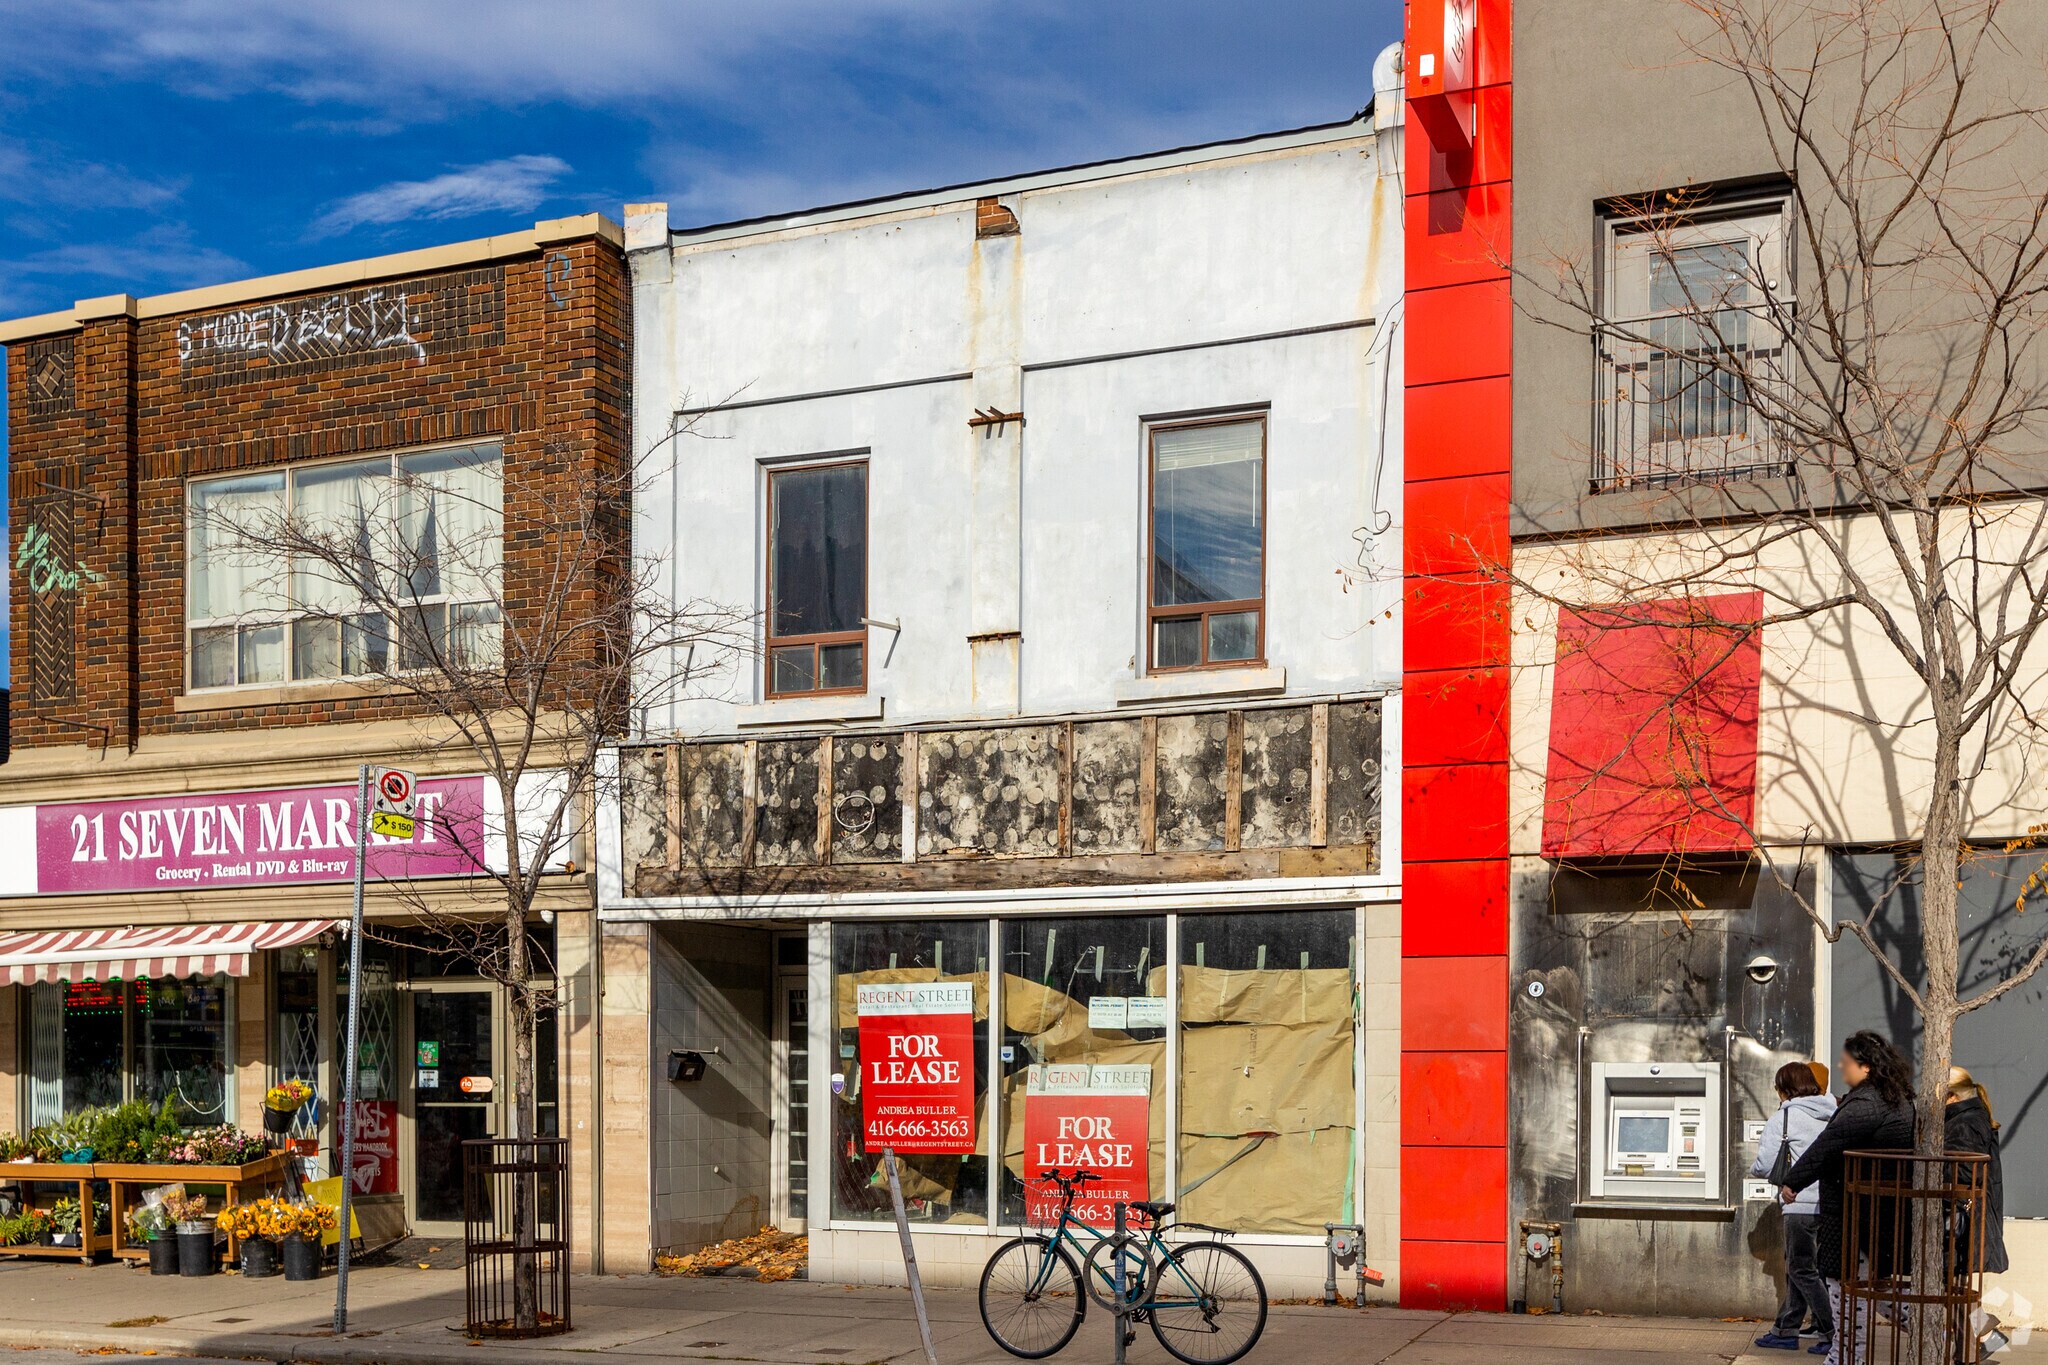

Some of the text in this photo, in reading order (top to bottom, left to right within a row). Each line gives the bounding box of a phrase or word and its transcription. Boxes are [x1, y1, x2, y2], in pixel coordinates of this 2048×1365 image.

[70, 812, 108, 862] 21
[118, 804, 247, 861] SEVEN
[398, 822, 412, 832] 150
[155, 858, 349, 881] Grocery Rental DVD & Blu-ray
[859, 988, 972, 1004] REGENT STREET
[887, 1034, 944, 1059] FOR
[871, 1060, 961, 1085] LEASE
[1029, 1070, 1150, 1084] RGENT STREET
[460, 1079, 473, 1088] ria
[877, 1105, 957, 1115] ANDREA BULLER
[868, 1119, 969, 1137] 416-666-3563
[1056, 1115, 1116, 1140] FOR
[1037, 1143, 1134, 1168] LEASE
[1086, 1189, 1130, 1200] BULLER
